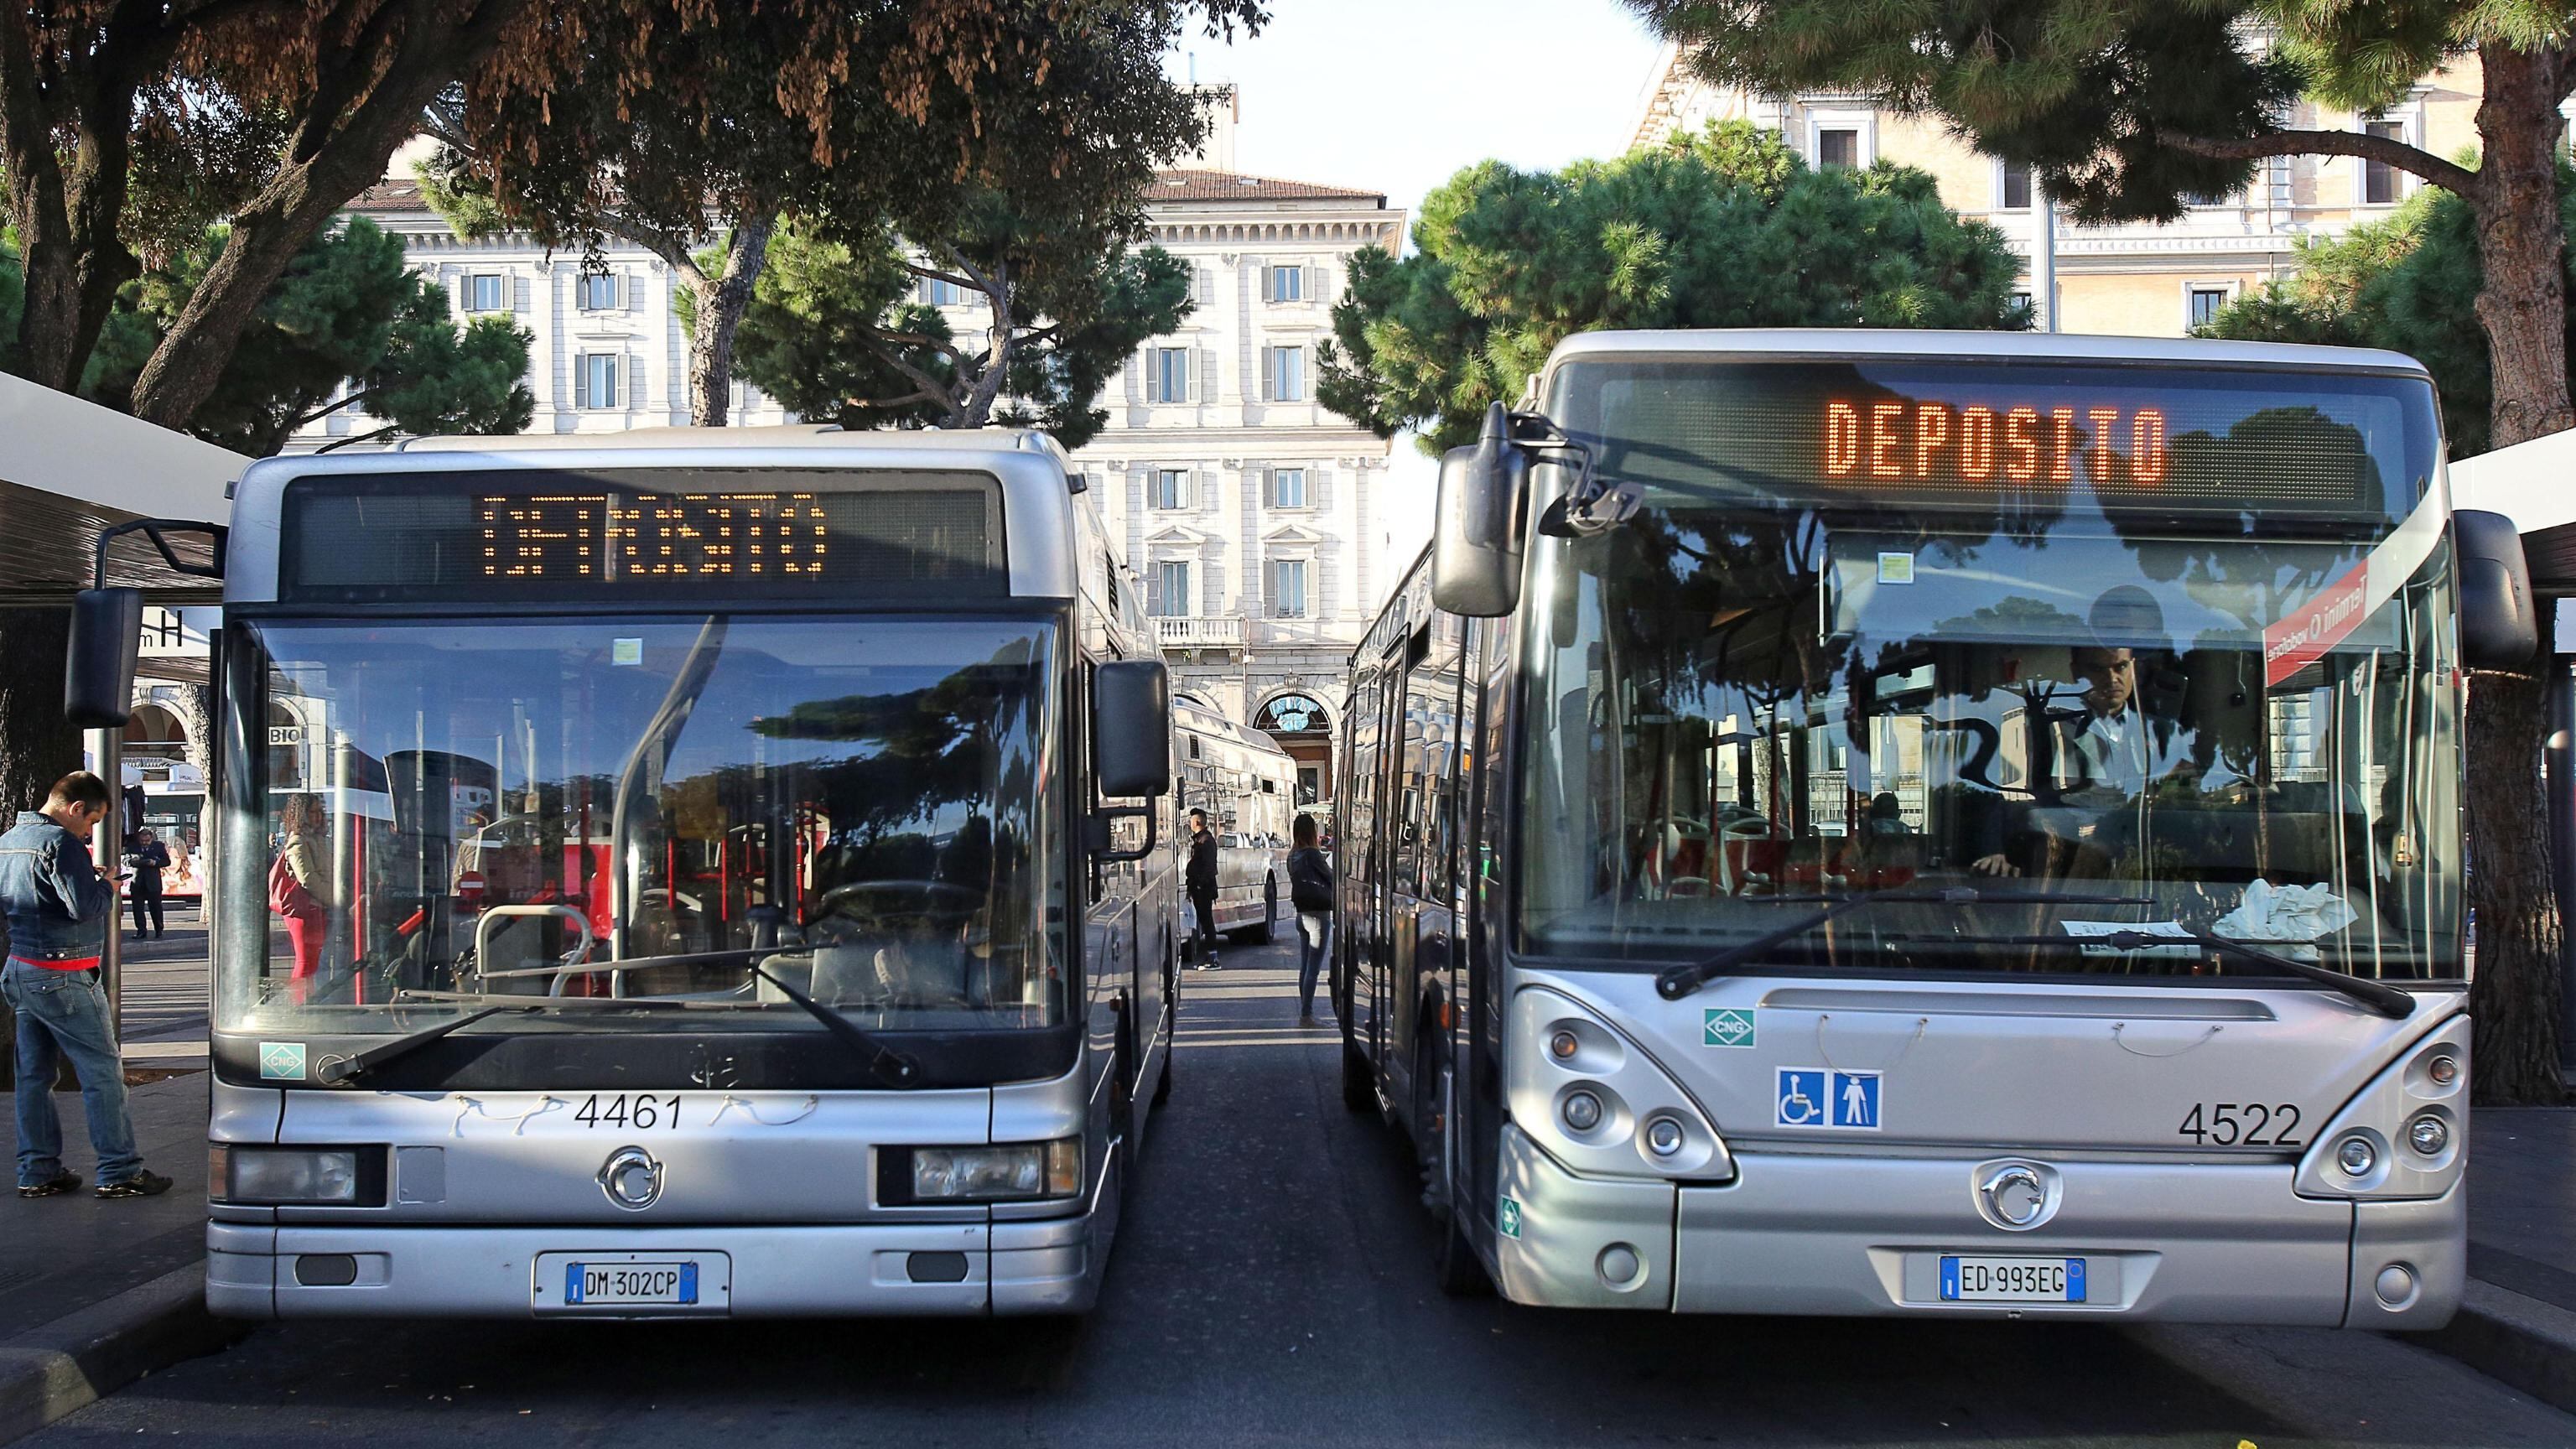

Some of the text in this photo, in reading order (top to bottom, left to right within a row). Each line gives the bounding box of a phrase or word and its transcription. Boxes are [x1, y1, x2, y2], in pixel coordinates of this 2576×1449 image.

[1827, 402, 2163, 482] DEPOSITO
[1714, 1021, 1744, 1034] CNG
[270, 1056, 296, 1067] CNG
[574, 1093, 681, 1130] 4461
[2179, 1103, 2302, 1146] 4522
